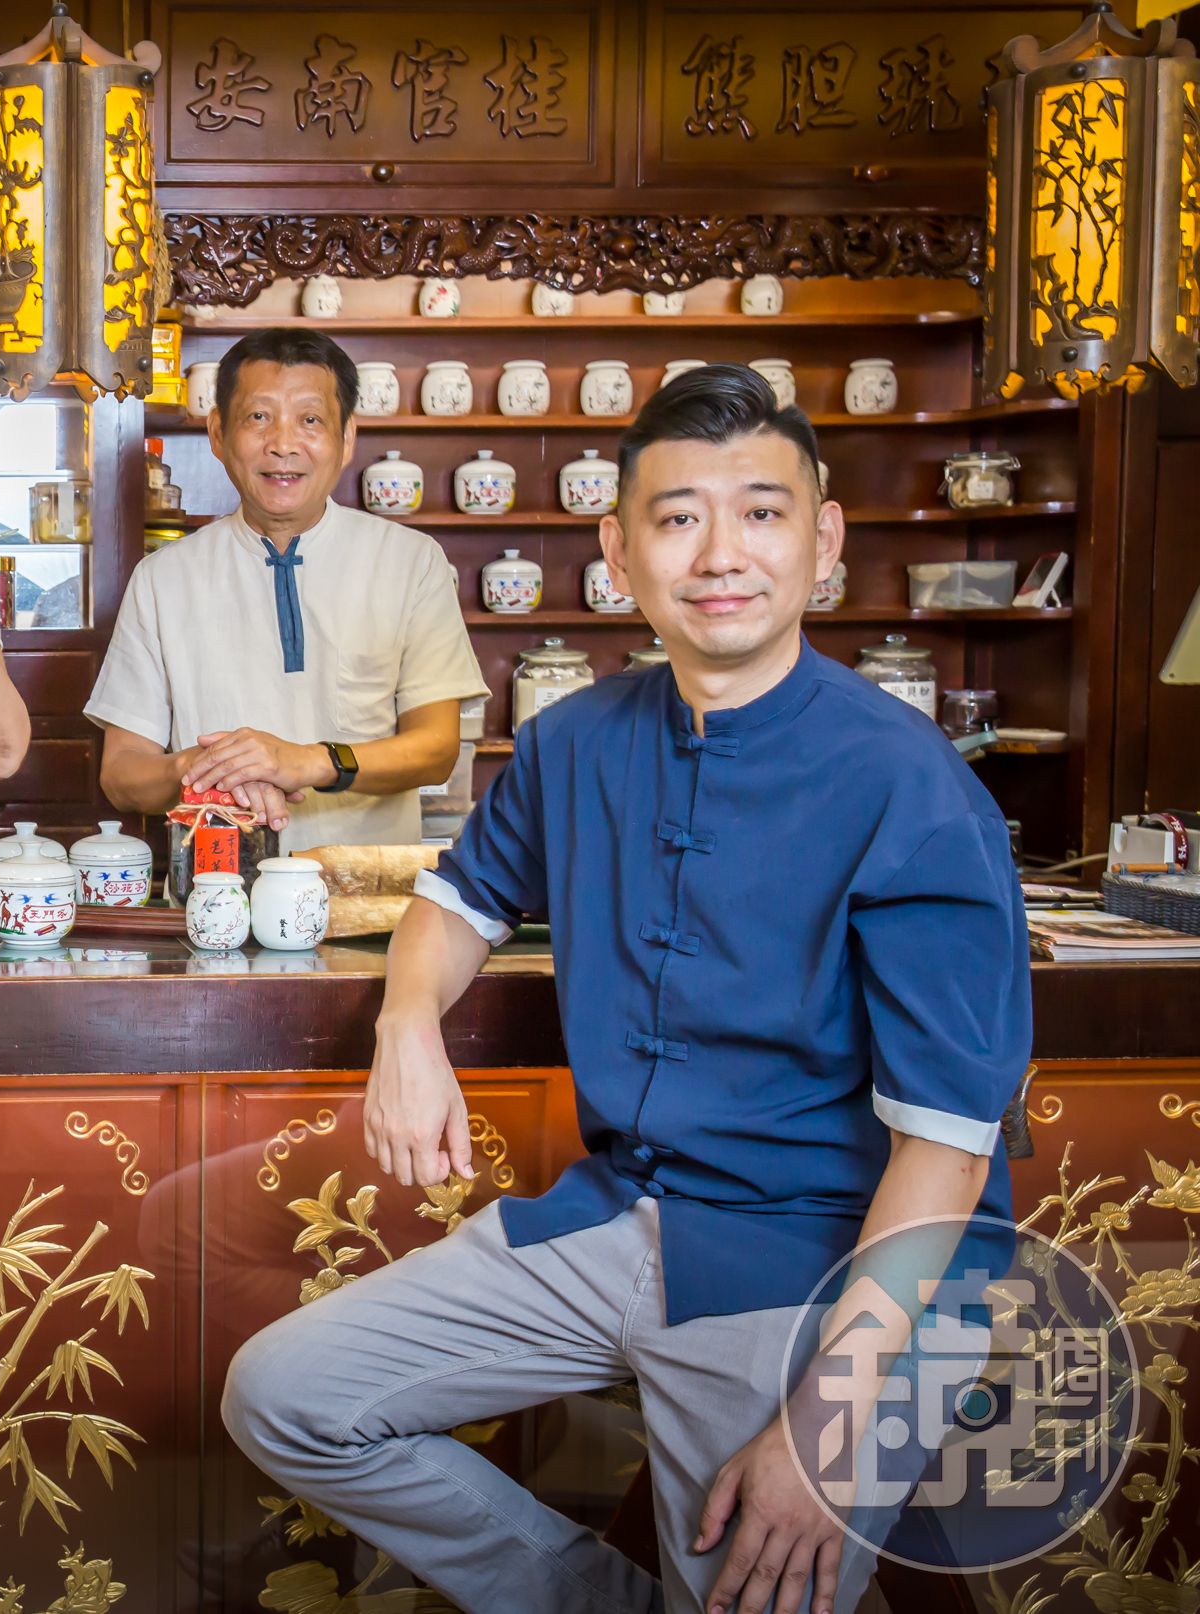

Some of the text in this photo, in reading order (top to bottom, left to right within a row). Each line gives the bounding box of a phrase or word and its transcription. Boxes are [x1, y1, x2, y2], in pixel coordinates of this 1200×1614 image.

[186, 33, 569, 144] 安南官桂
[681, 32, 1004, 140] 熊胆琥
